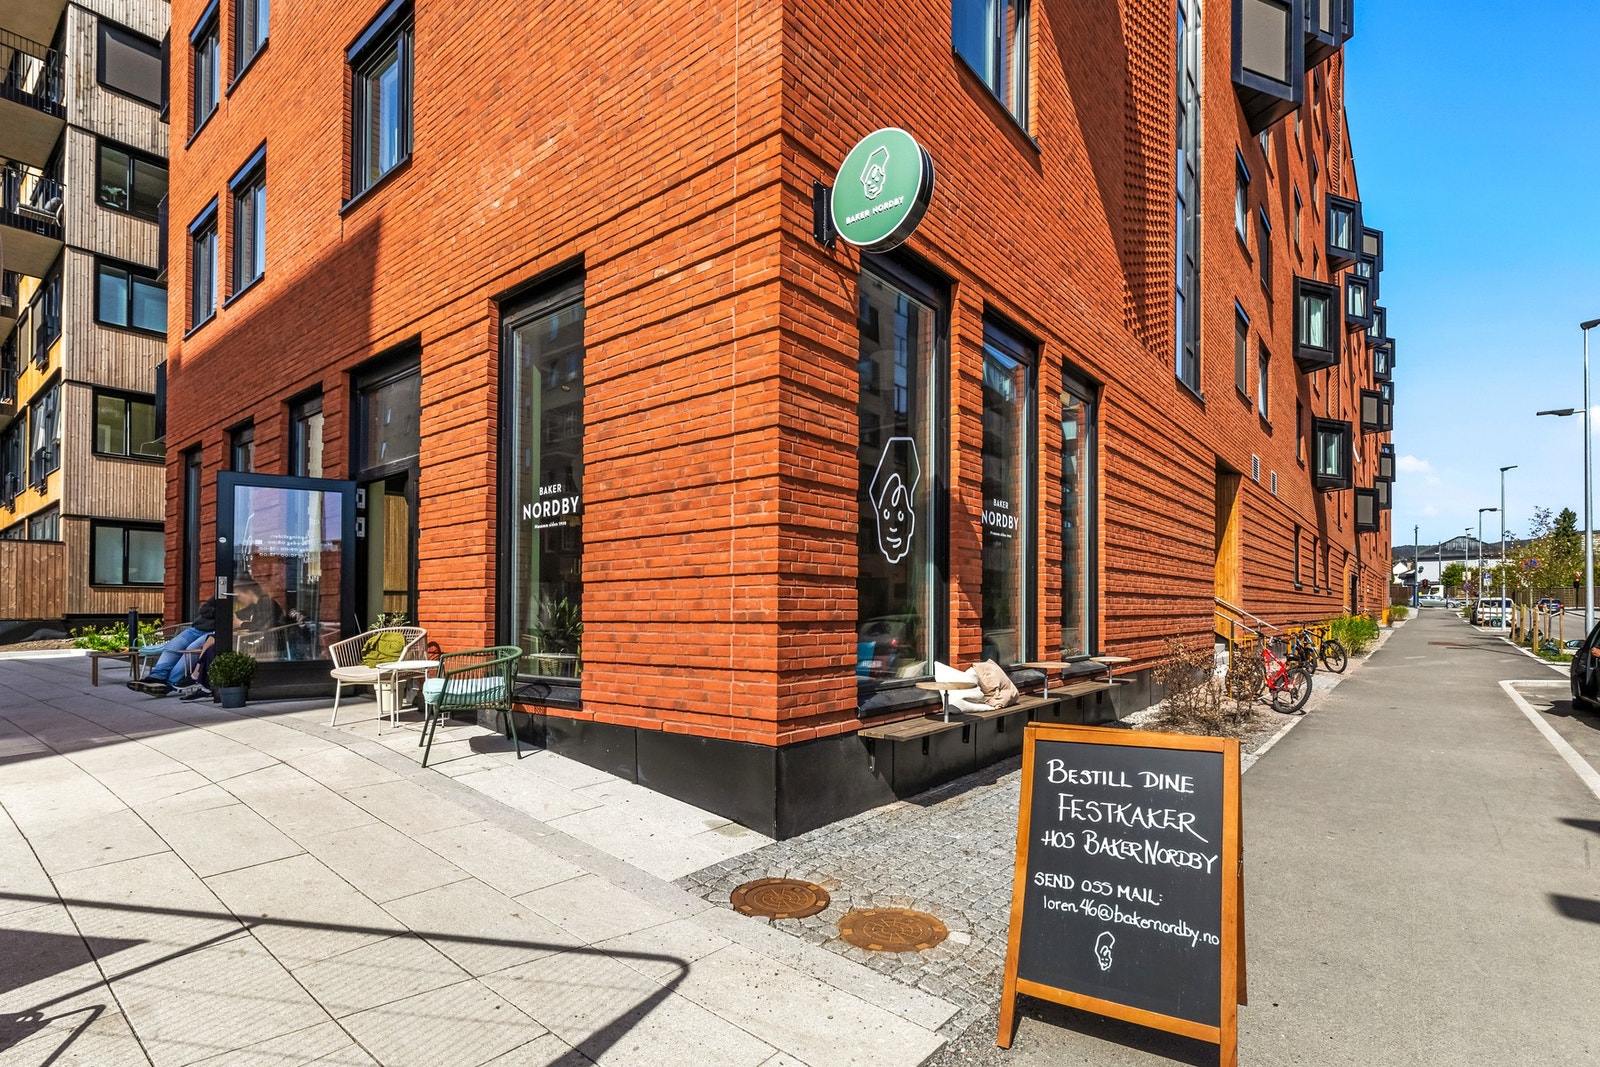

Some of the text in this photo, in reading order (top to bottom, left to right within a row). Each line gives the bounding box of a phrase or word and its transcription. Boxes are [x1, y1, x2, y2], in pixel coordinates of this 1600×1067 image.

[845, 196, 904, 225] BAKER NORDBY
[539, 483, 562, 496] BAKER
[523, 496, 579, 520] NORDBY
[993, 498, 1009, 510] BAKER
[981, 509, 1019, 530] NORDBY
[1046, 758, 1195, 794] BESTILL DINE
[1057, 792, 1209, 843] FESTKAKER
[1040, 829, 1075, 849] HOS
[1034, 872, 1163, 906] SEND OSS MAIL:
